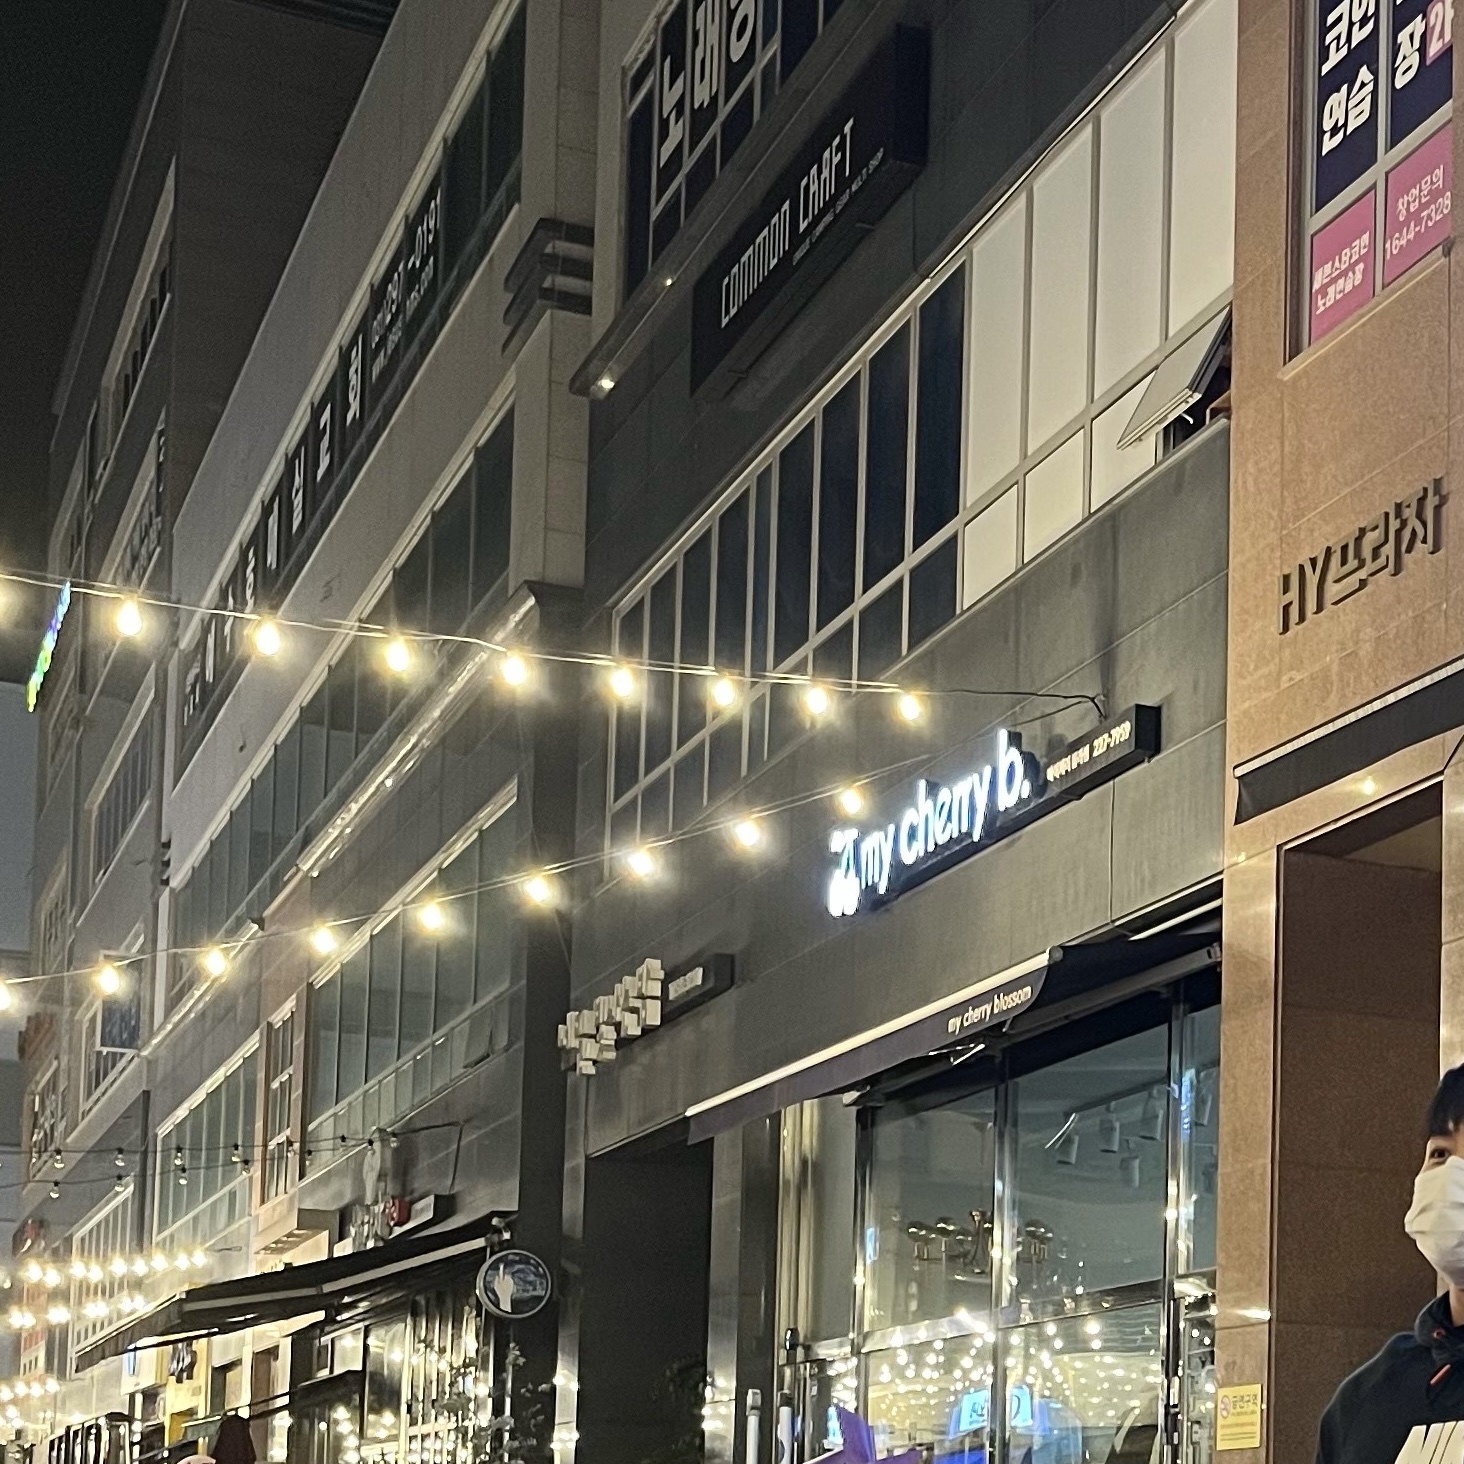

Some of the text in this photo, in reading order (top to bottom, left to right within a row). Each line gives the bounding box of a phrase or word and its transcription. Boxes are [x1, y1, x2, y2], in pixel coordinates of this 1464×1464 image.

[721, 117, 854, 329] COMMON CRAFT
[1384, 190, 1452, 261] 1644-7328
[1396, 164, 1445, 222] 창업문의
[1278, 477, 1450, 635] HY프라자
[860, 823, 896, 895] my
[899, 778, 992, 866] cherry
[947, 985, 1033, 1036] my cherry blossom
